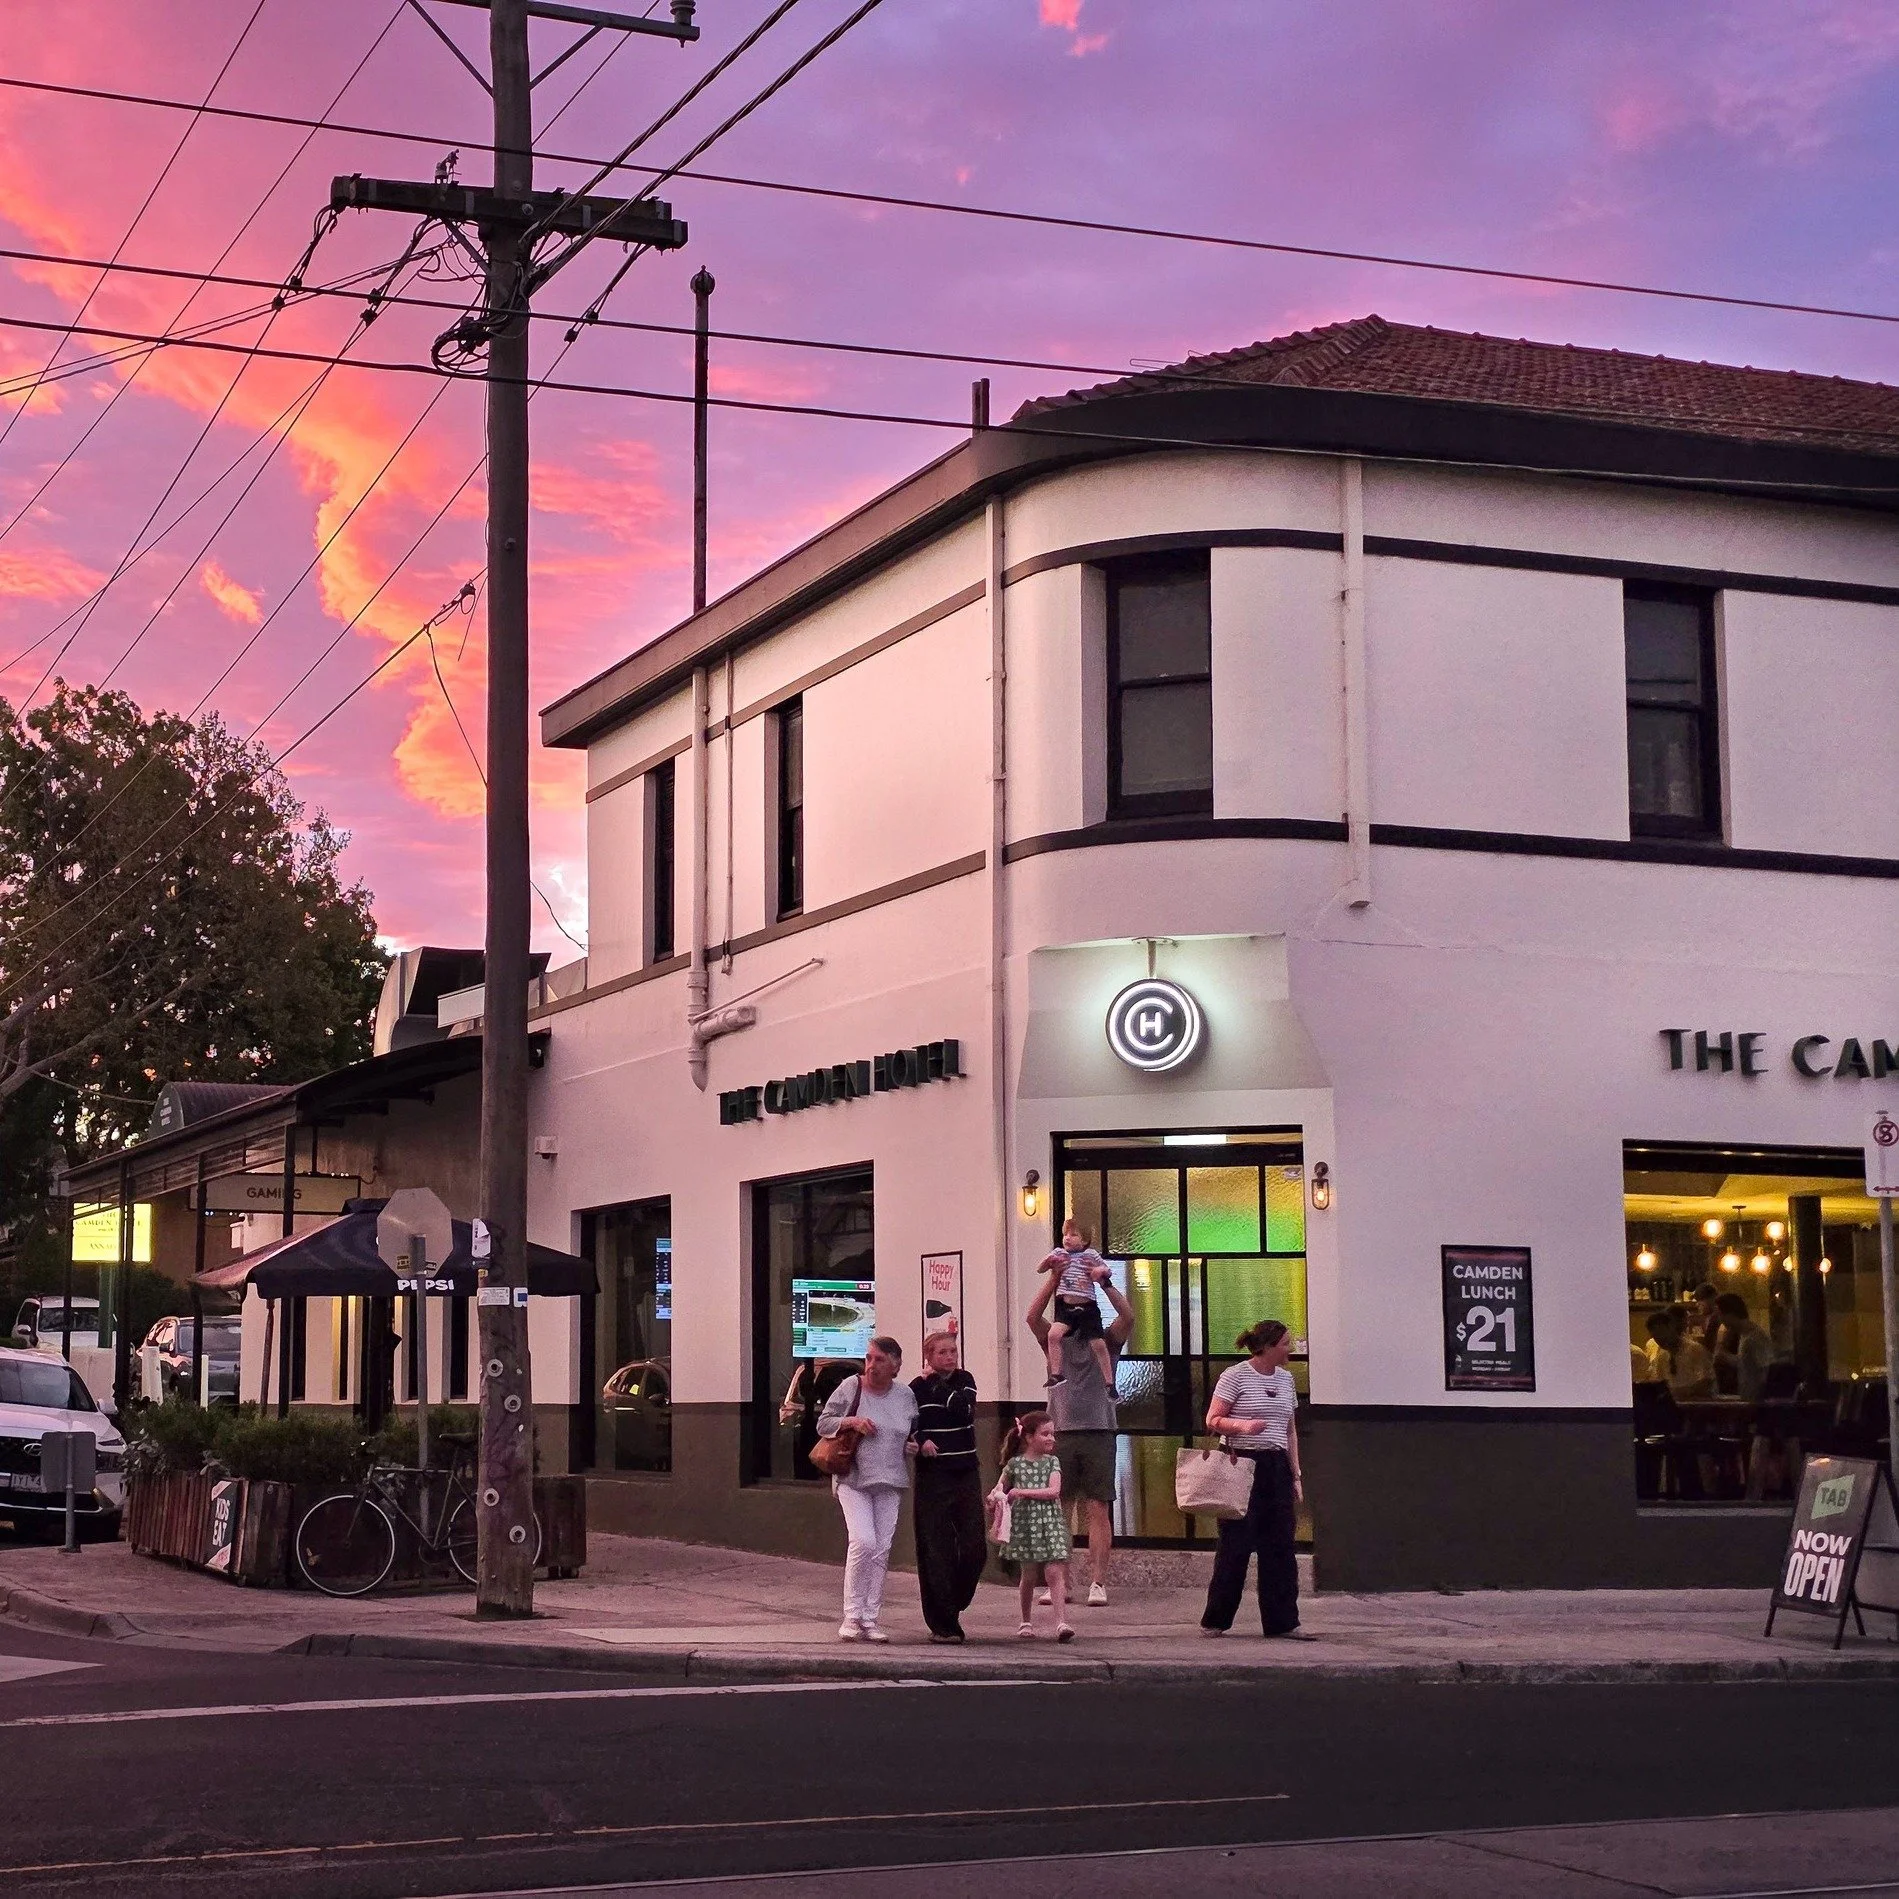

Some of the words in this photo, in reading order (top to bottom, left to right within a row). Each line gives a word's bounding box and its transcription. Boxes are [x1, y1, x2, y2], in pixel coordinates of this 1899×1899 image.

[1659, 1028, 1769, 1076] THE
[717, 1086, 763, 1125] THE
[764, 1060, 871, 1114] CAMDEN
[874, 1038, 967, 1092] HOTEL
[246, 1187, 302, 1200] GAMIG
[928, 1259, 955, 1280] Happy
[1452, 1264, 1523, 1280] CAMDEN
[931, 1275, 951, 1292] Hour
[1461, 1285, 1516, 1300] LUNCH
[1820, 1487, 1848, 1508] TAB
[212, 1519, 227, 1547] EAT
[1794, 1529, 1852, 1556] NOW
[1783, 1552, 1845, 1603] OPEN
